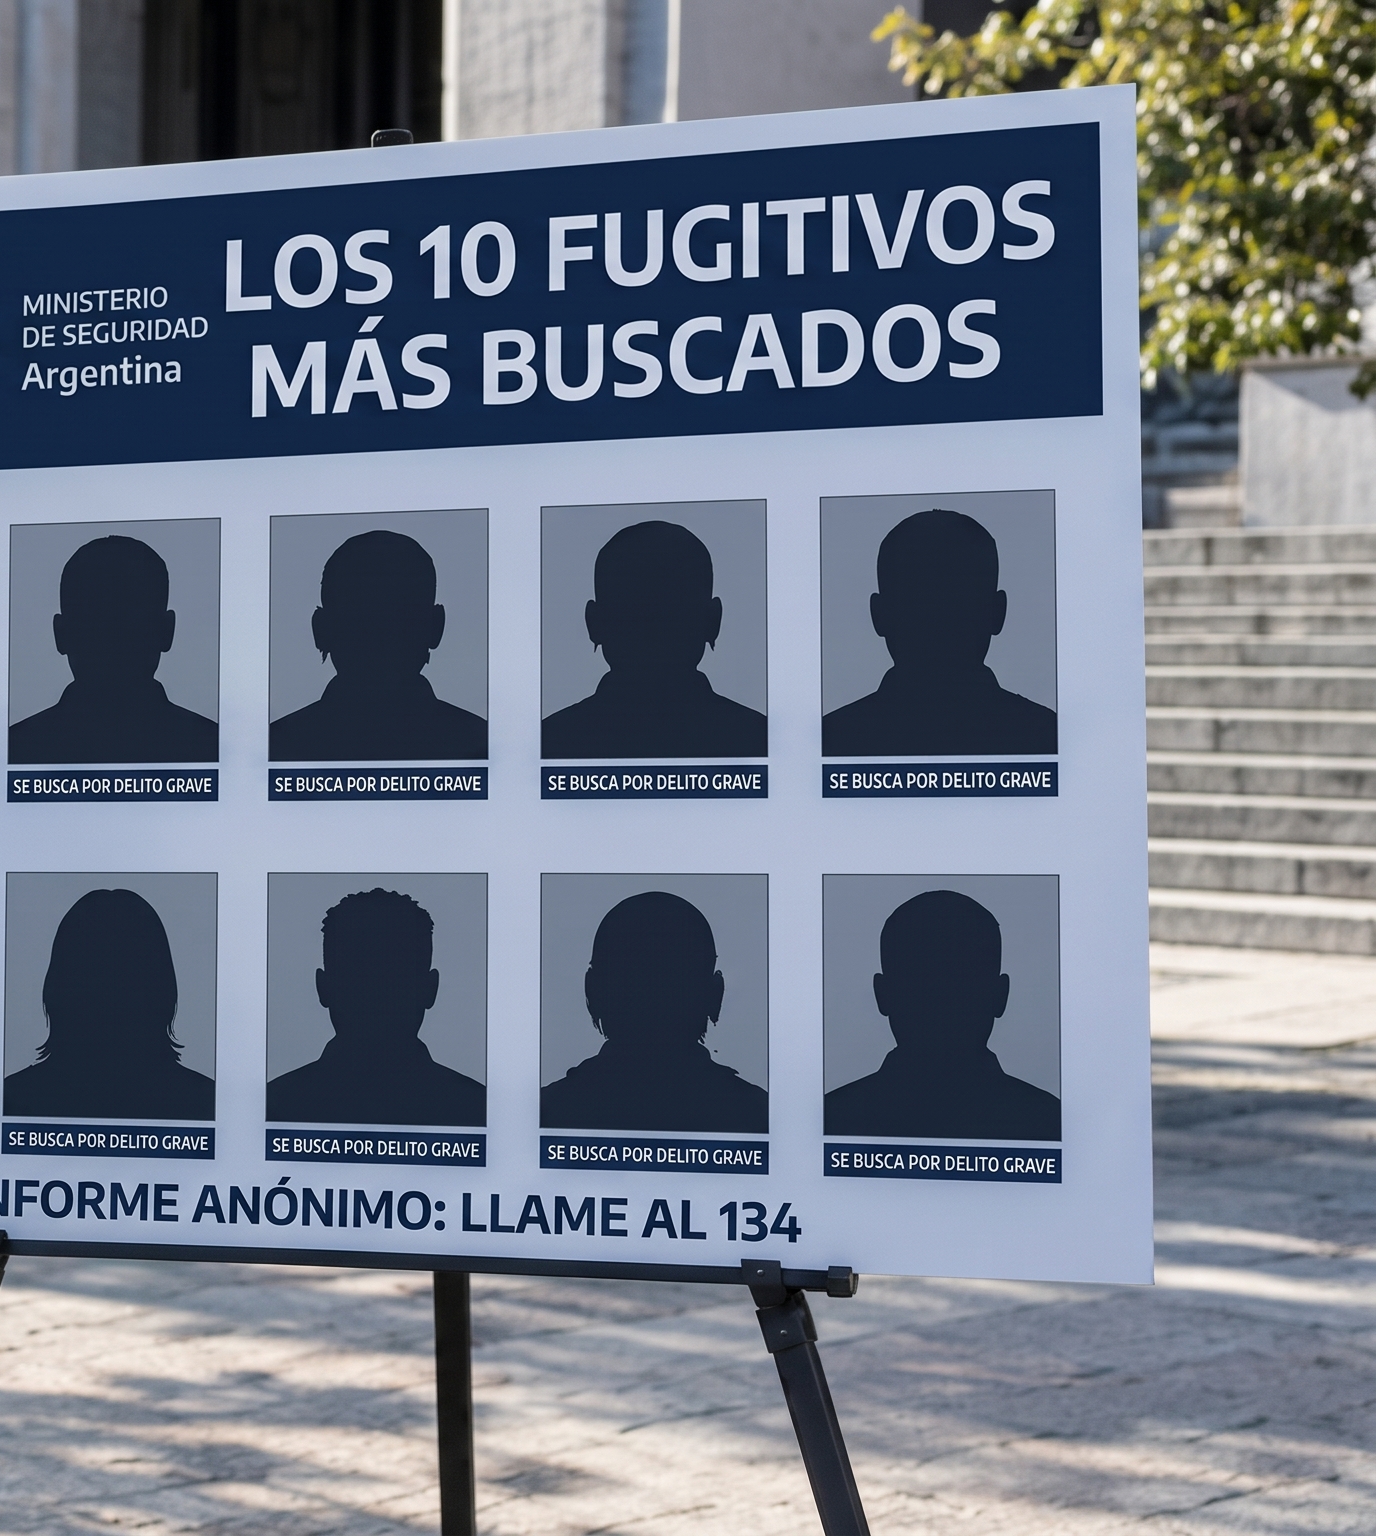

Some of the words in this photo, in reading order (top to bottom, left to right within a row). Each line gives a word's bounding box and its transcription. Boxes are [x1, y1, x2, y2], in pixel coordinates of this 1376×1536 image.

[225, 229, 393, 313] LOS
[419, 221, 516, 300] 10
[548, 179, 1055, 292] FUGITIVOS
[23, 286, 168, 317] MINISTERIO
[23, 325, 56, 349] DE
[62, 316, 209, 346] SEGURIDAD
[251, 315, 451, 418] MÁS
[483, 299, 1001, 405] BUSCADOS
[21, 354, 181, 397] Argentina
[13, 779, 31, 794] SE
[33, 778, 79, 794] BUSCA
[82, 778, 111, 794] POR
[114, 778, 163, 793] DELITO
[166, 777, 212, 793] GRAVE
[274, 777, 293, 793] SE
[296, 776, 344, 793] BUSCA
[347, 776, 377, 792] POR
[380, 776, 431, 792] DELITO
[433, 775, 482, 792] GRAVE
[548, 775, 567, 791] SE
[570, 774, 620, 791] BUSCA
[622, 774, 653, 791] POR
[657, 774, 709, 790] DELITO
[712, 773, 762, 790] GRAVE
[829, 773, 849, 789] SE
[852, 772, 904, 789] BUSCA
[906, 772, 939, 789] POR
[942, 771, 997, 789] DELITO
[999, 771, 1051, 788] GRAVE
[8, 1131, 26, 1146] SE
[29, 1131, 75, 1147] BUSCA
[78, 1133, 106, 1148] POR
[109, 1133, 159, 1150] DELITO
[162, 1135, 209, 1151] GRAVE
[272, 1137, 290, 1153] SE
[293, 1138, 341, 1154] BUSCA
[344, 1139, 374, 1155] POR
[377, 1140, 428, 1157] DELITO
[431, 1142, 480, 1158] GRAVE
[547, 1144, 566, 1160] SE
[569, 1145, 619, 1162] BUSCA
[622, 1146, 653, 1163] POR
[656, 1147, 709, 1164] DELITO
[712, 1149, 763, 1166] GRAVE
[831, 1152, 850, 1168] SE
[853, 1152, 905, 1170] BUSCA
[909, 1154, 941, 1171] POR
[945, 1155, 1000, 1173] DELITO
[1003, 1157, 1056, 1174] GRAVE
[191, 1176, 446, 1231] ANÓNIMO:
[462, 1192, 628, 1238] LLAME
[641, 1198, 707, 1240] AL
[719, 1201, 802, 1244] 134
